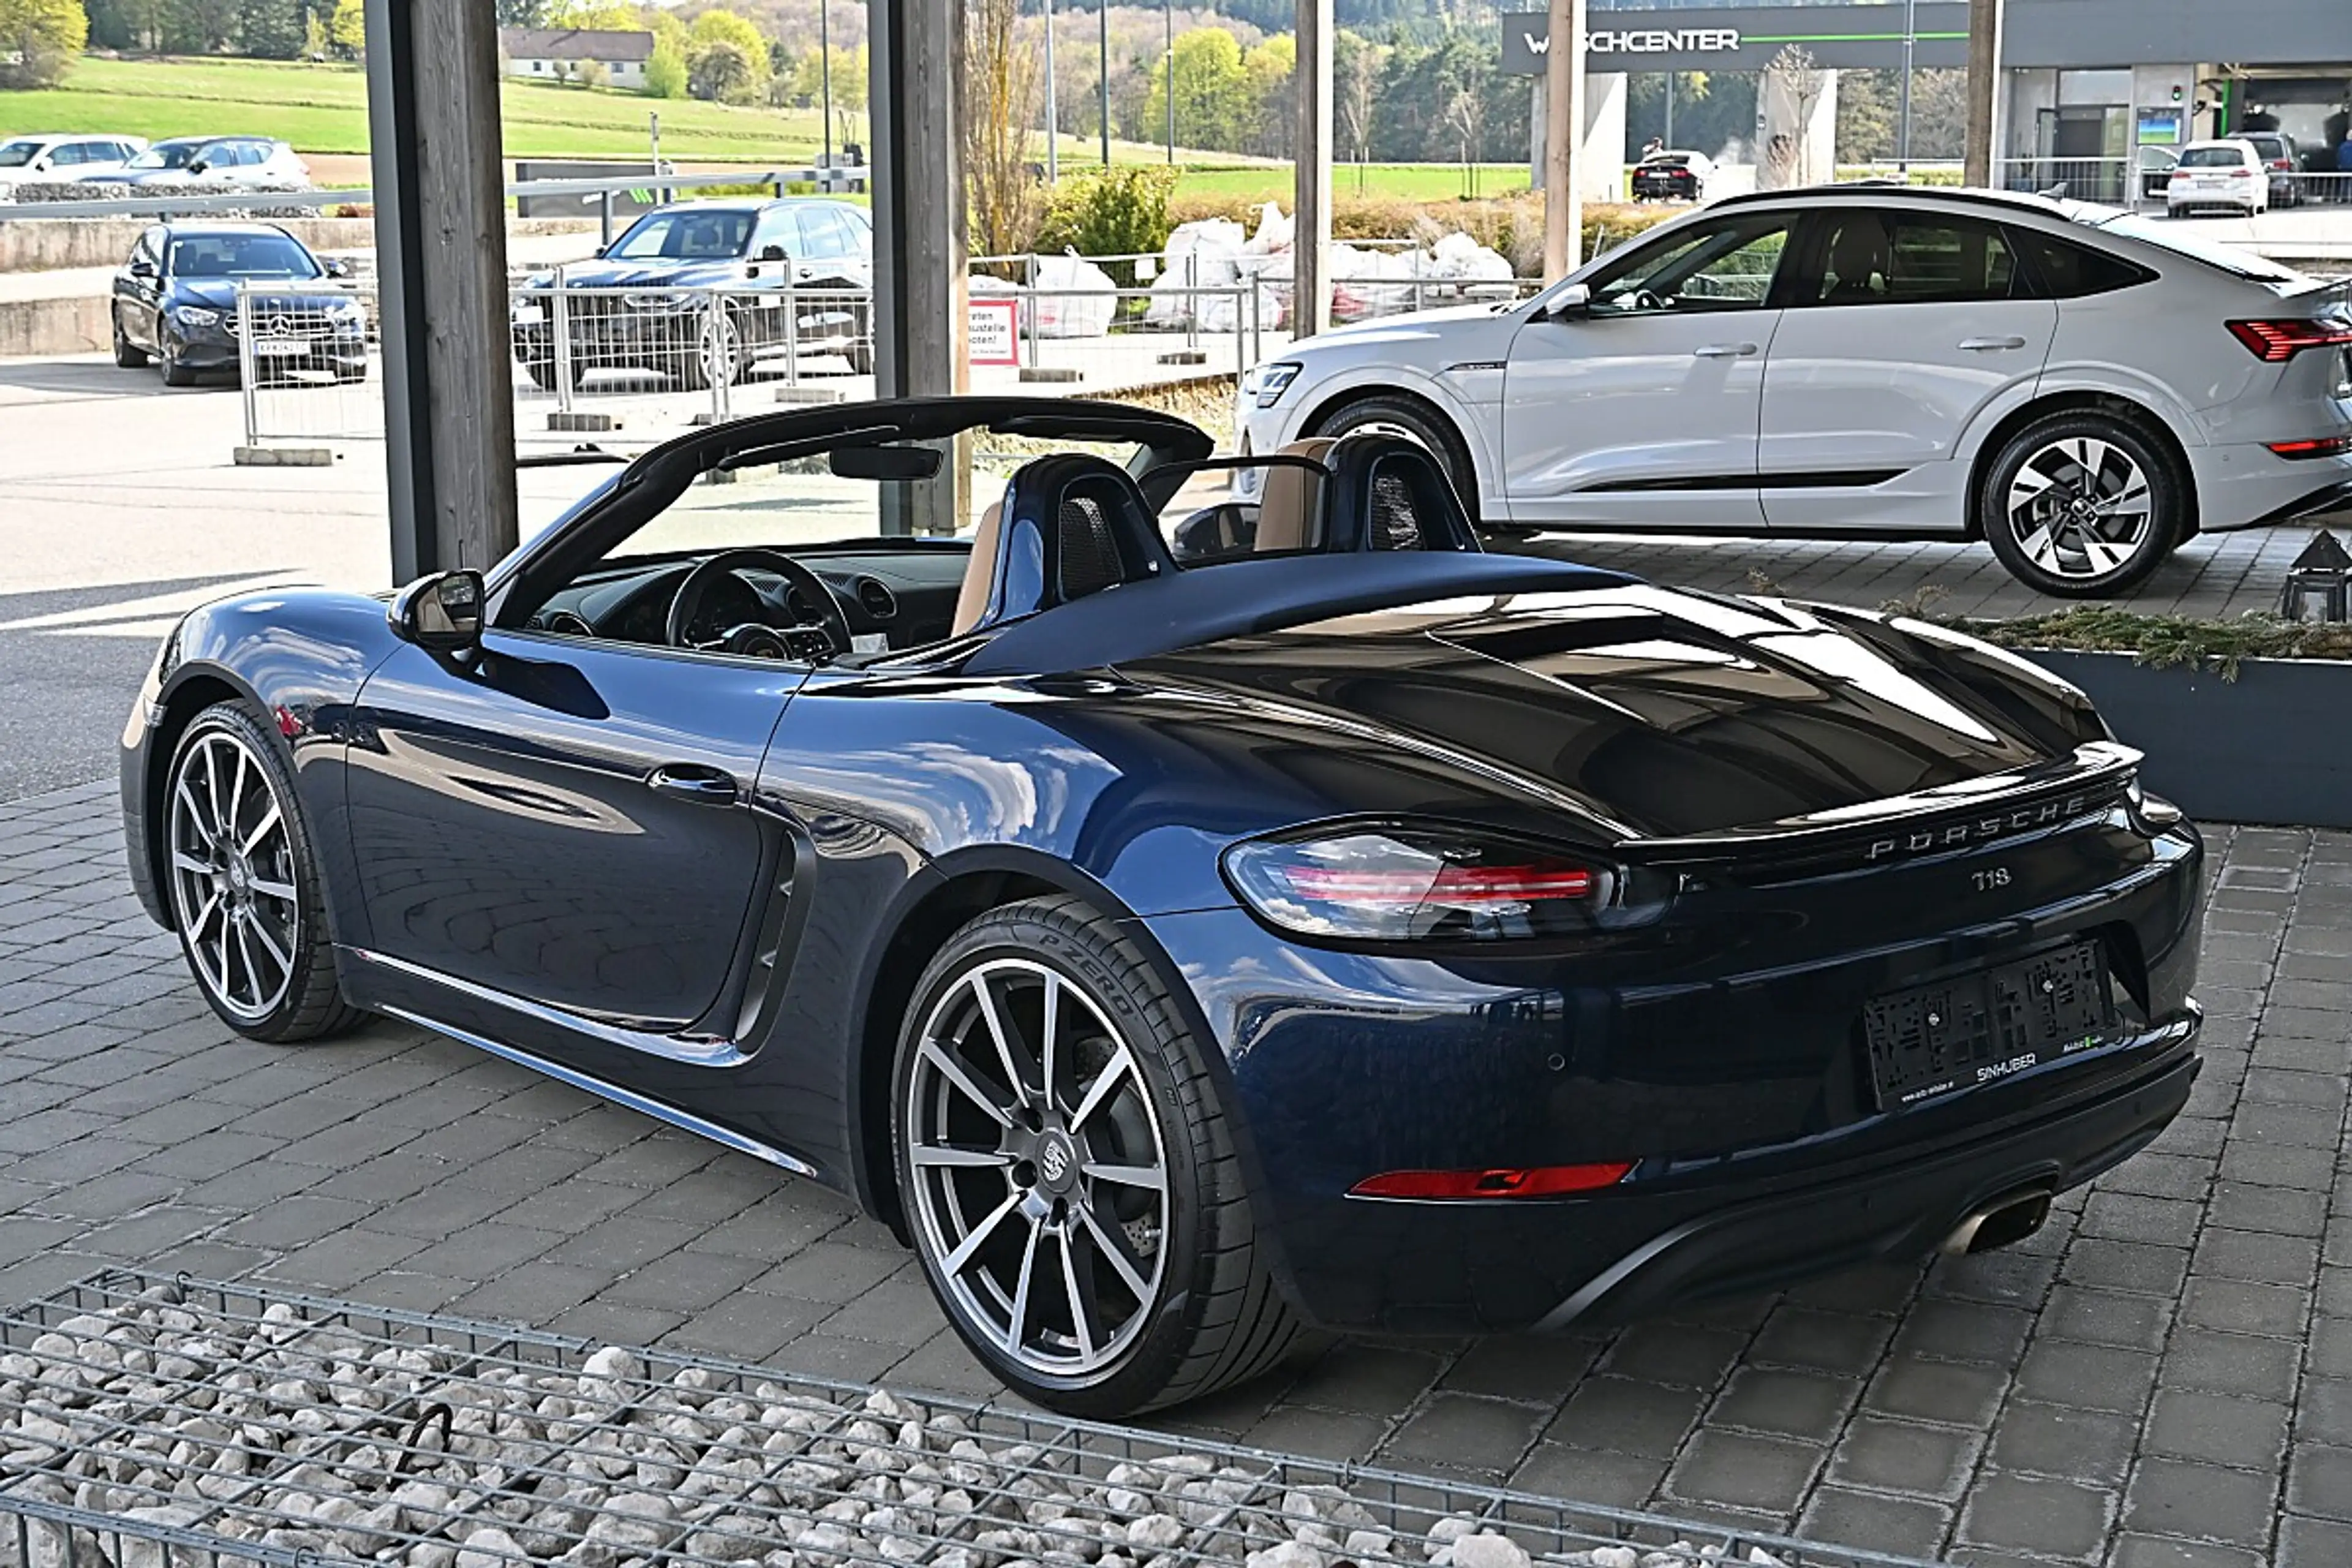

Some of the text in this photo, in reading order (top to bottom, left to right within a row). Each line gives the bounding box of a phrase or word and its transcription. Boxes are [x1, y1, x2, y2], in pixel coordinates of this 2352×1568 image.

[1524, 29, 1740, 55] WCHCENTER
[1865, 796, 2084, 859] PORSCHE
[1971, 867, 2012, 891] 718
[1039, 934, 1134, 1016] P ZERO
[1977, 1052, 2037, 1082] SINHUBER
